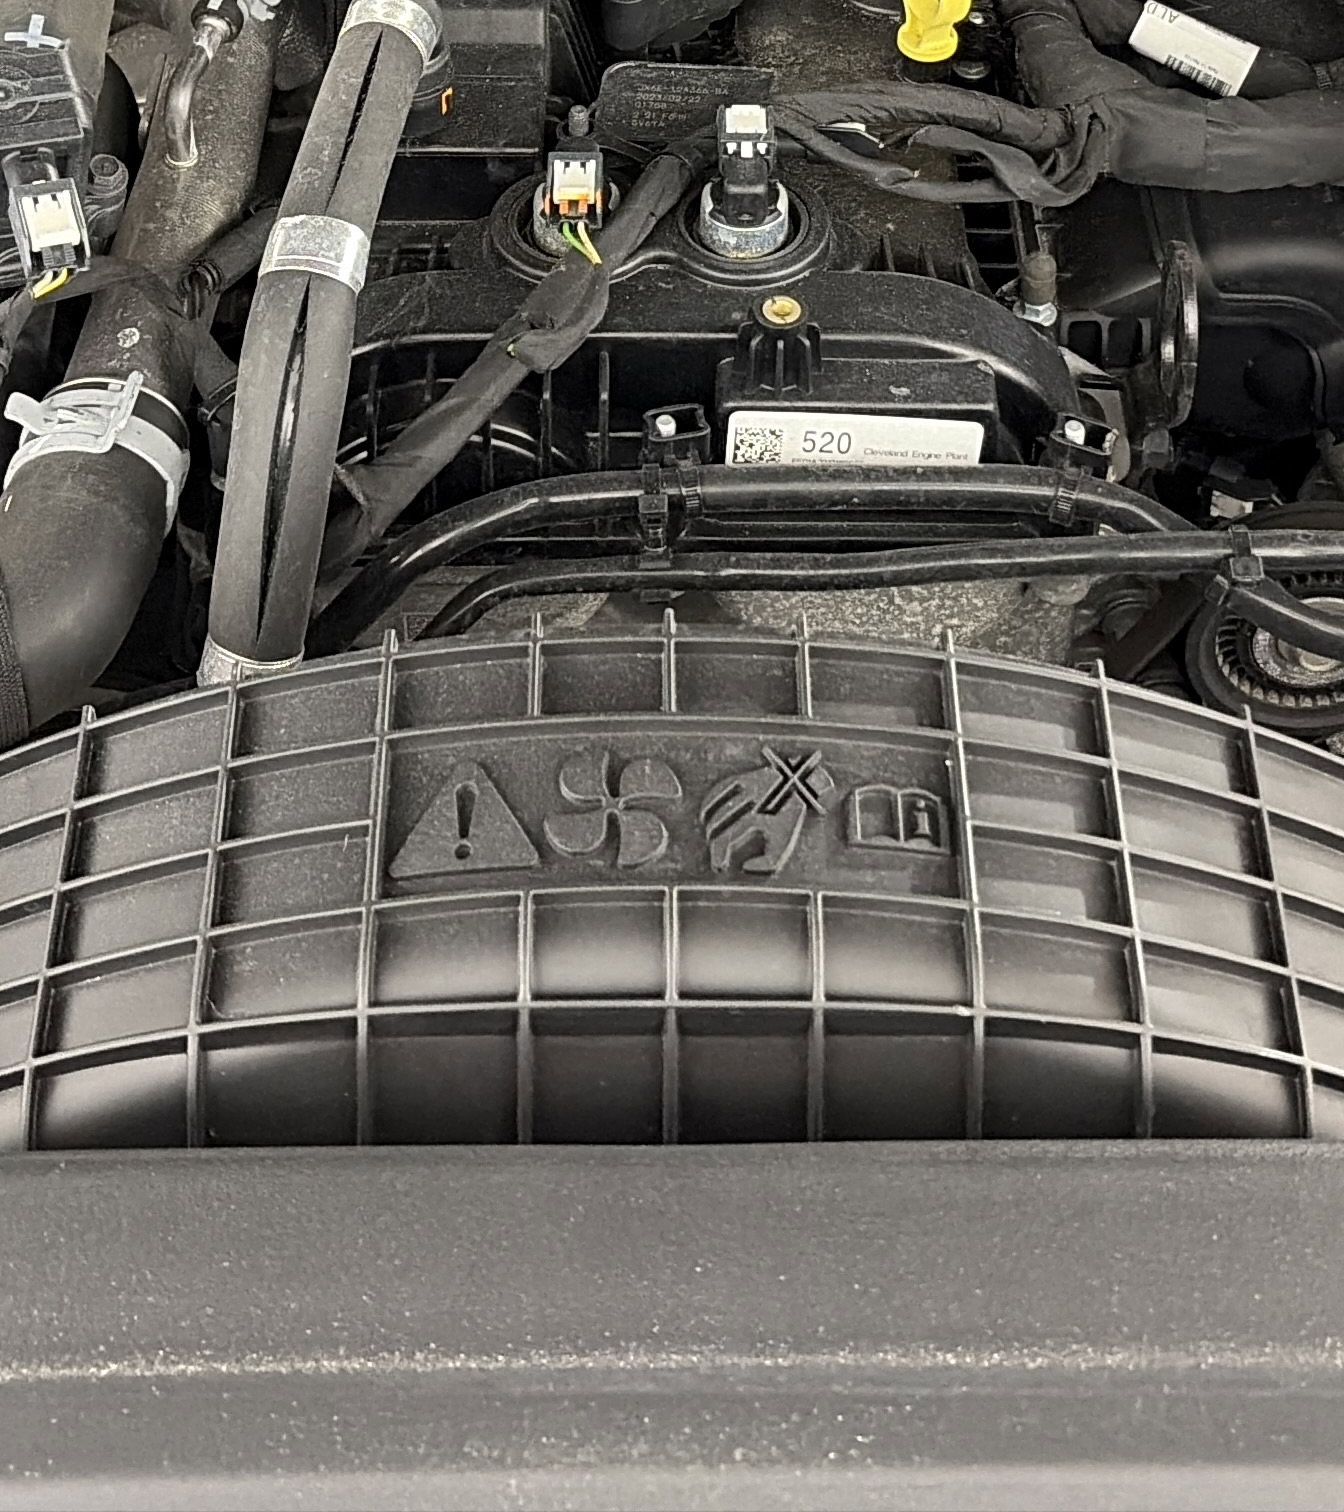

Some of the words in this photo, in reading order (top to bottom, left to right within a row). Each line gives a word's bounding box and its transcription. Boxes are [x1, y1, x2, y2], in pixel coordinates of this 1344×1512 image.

[802, 430, 853, 455] 520
[863, 448, 908, 458] Cleveland
[912, 450, 942, 461] Engine
[945, 451, 969, 461] Plant
